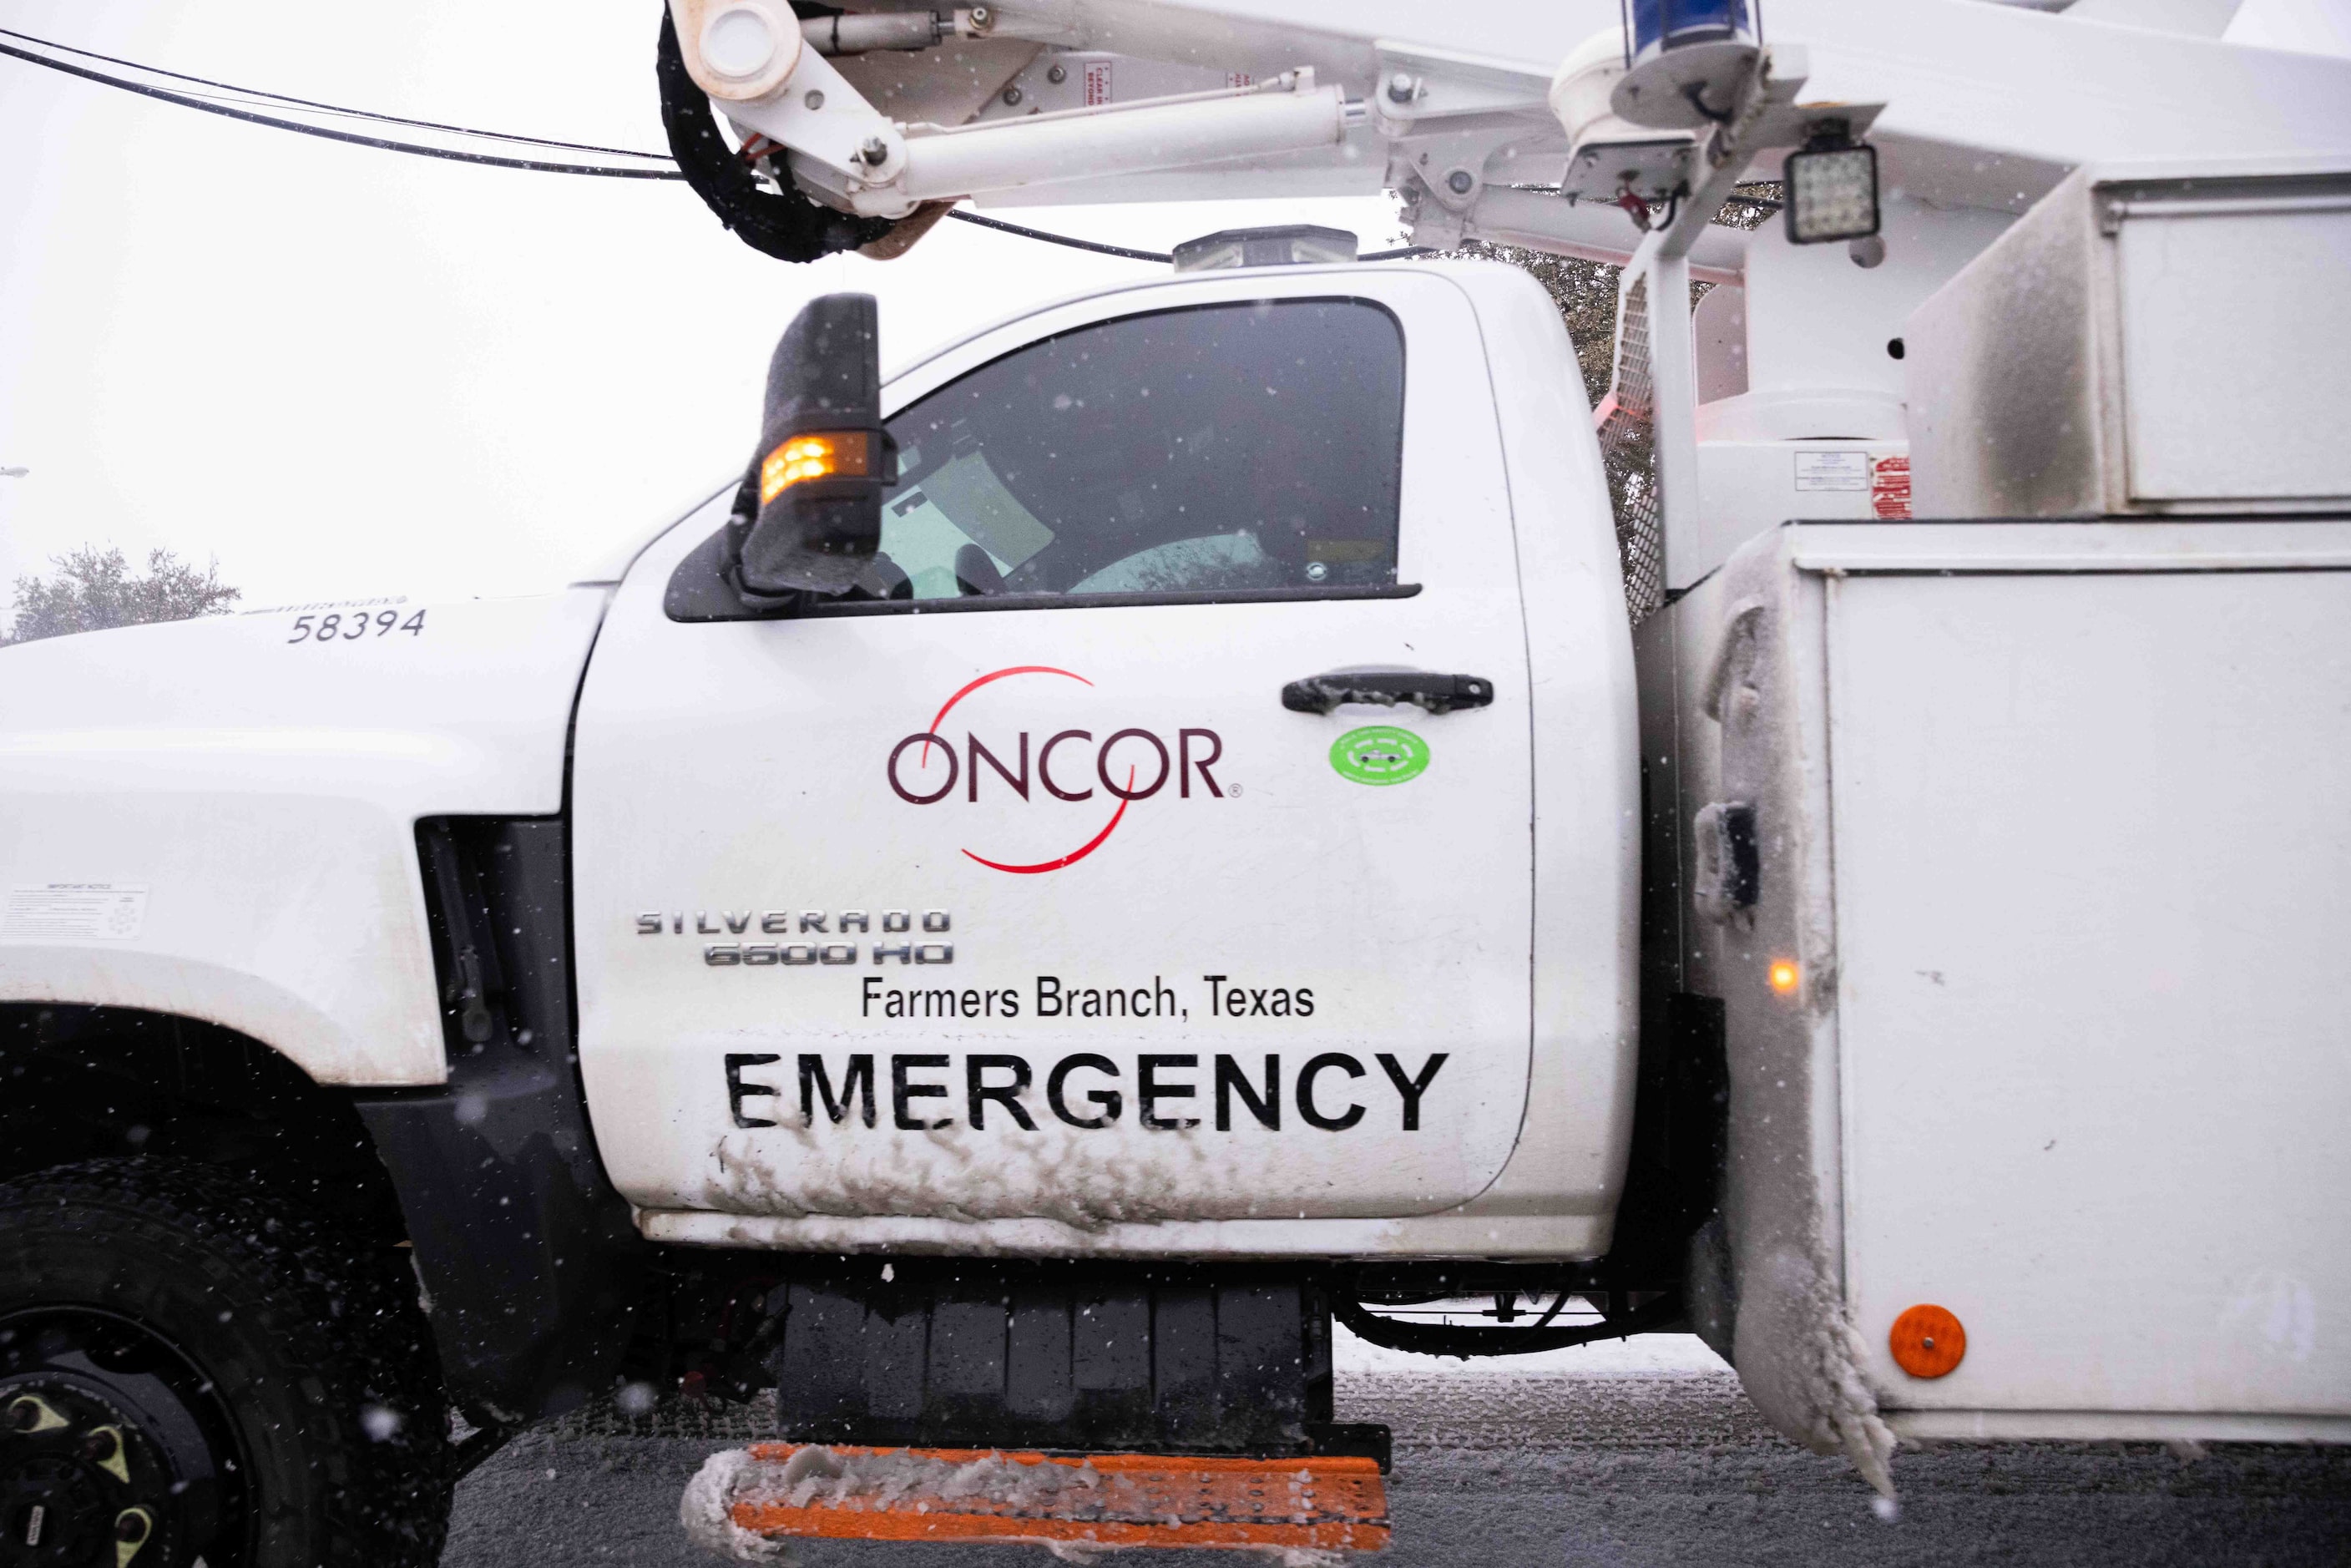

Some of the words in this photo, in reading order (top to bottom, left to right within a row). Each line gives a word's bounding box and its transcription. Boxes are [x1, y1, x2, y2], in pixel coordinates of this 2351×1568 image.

[286, 609, 427, 645] 58394
[635, 908, 951, 934] SILVERADO
[704, 940, 857, 966] 6500
[872, 940, 954, 965] HD
[862, 976, 1019, 1018] Farmers
[1036, 975, 1189, 1022] Branch,
[1204, 974, 1315, 1017] Texas
[724, 1052, 1450, 1131] EMERGENCY
